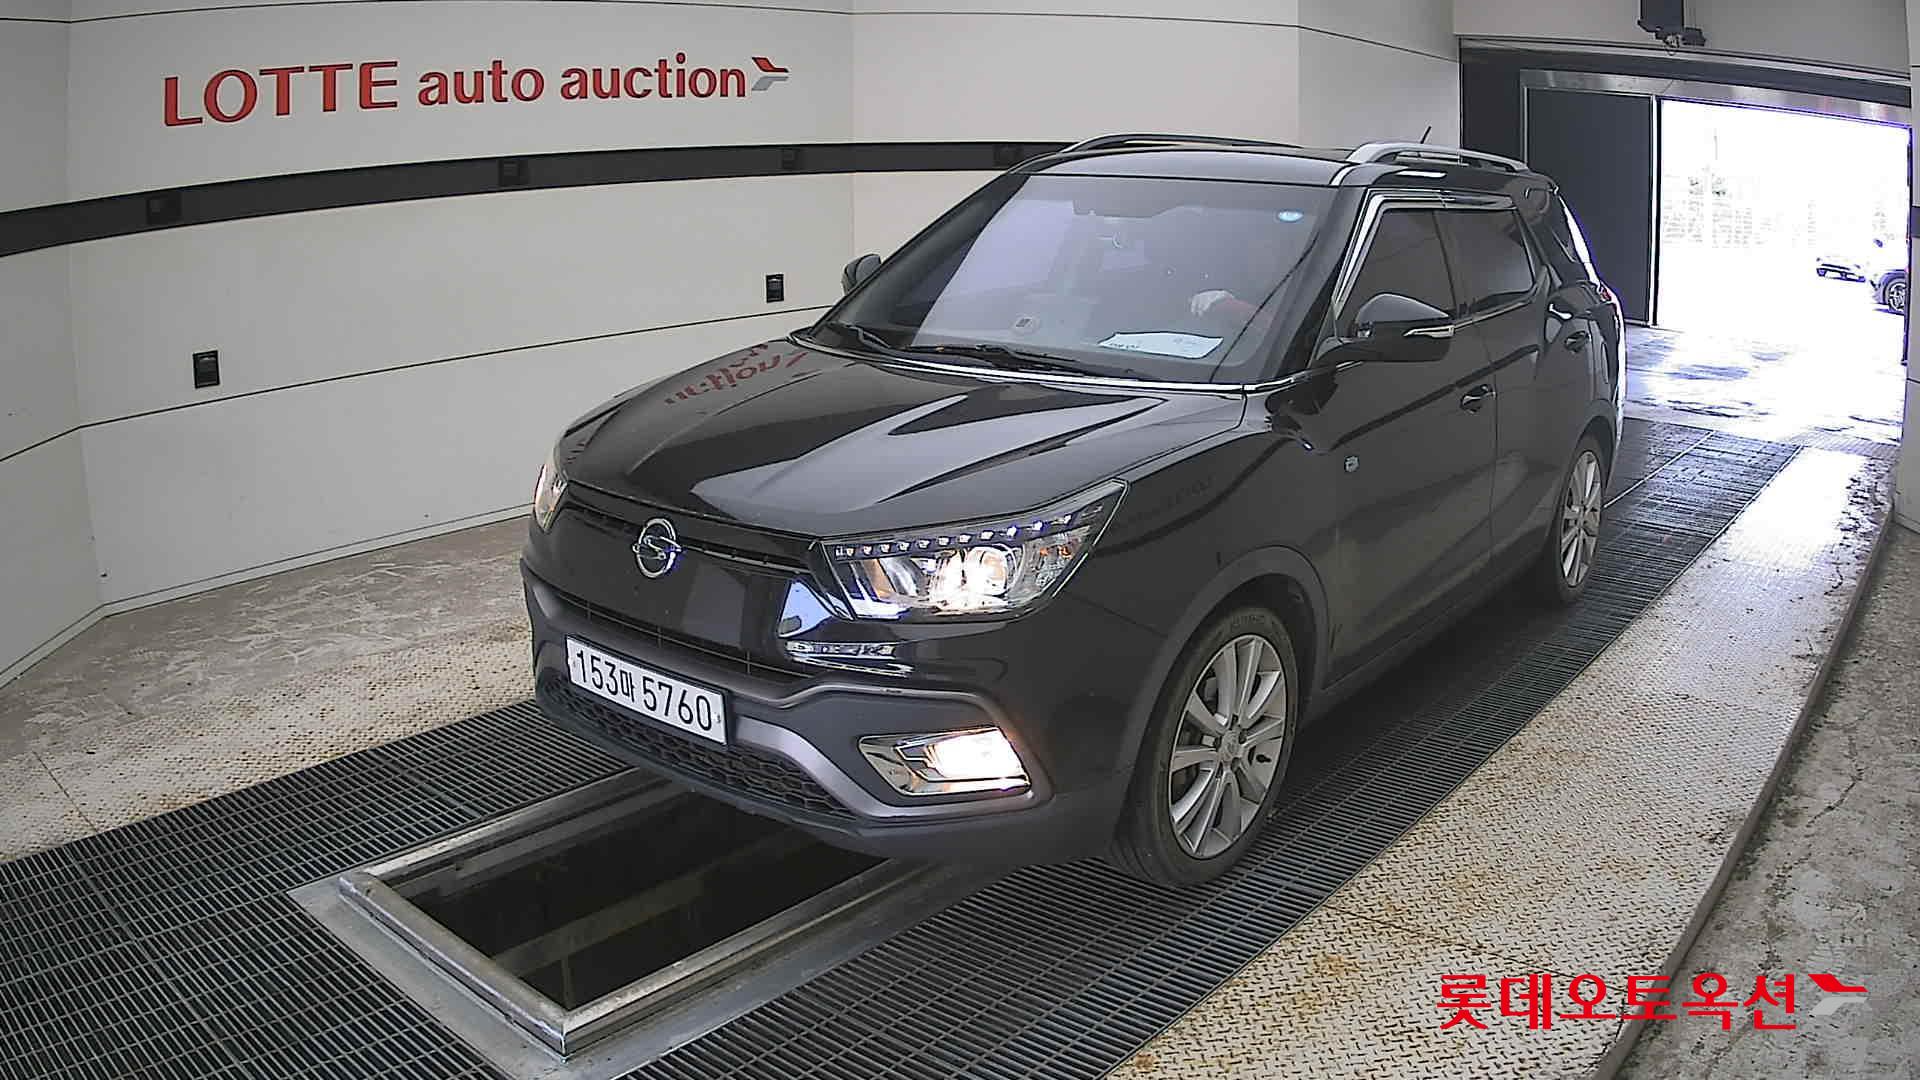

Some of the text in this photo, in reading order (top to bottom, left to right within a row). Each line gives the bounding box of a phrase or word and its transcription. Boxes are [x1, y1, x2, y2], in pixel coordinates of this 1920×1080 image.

[163, 52, 748, 127] LOTTE auto auction
[576, 649, 713, 732] 153마 5760
